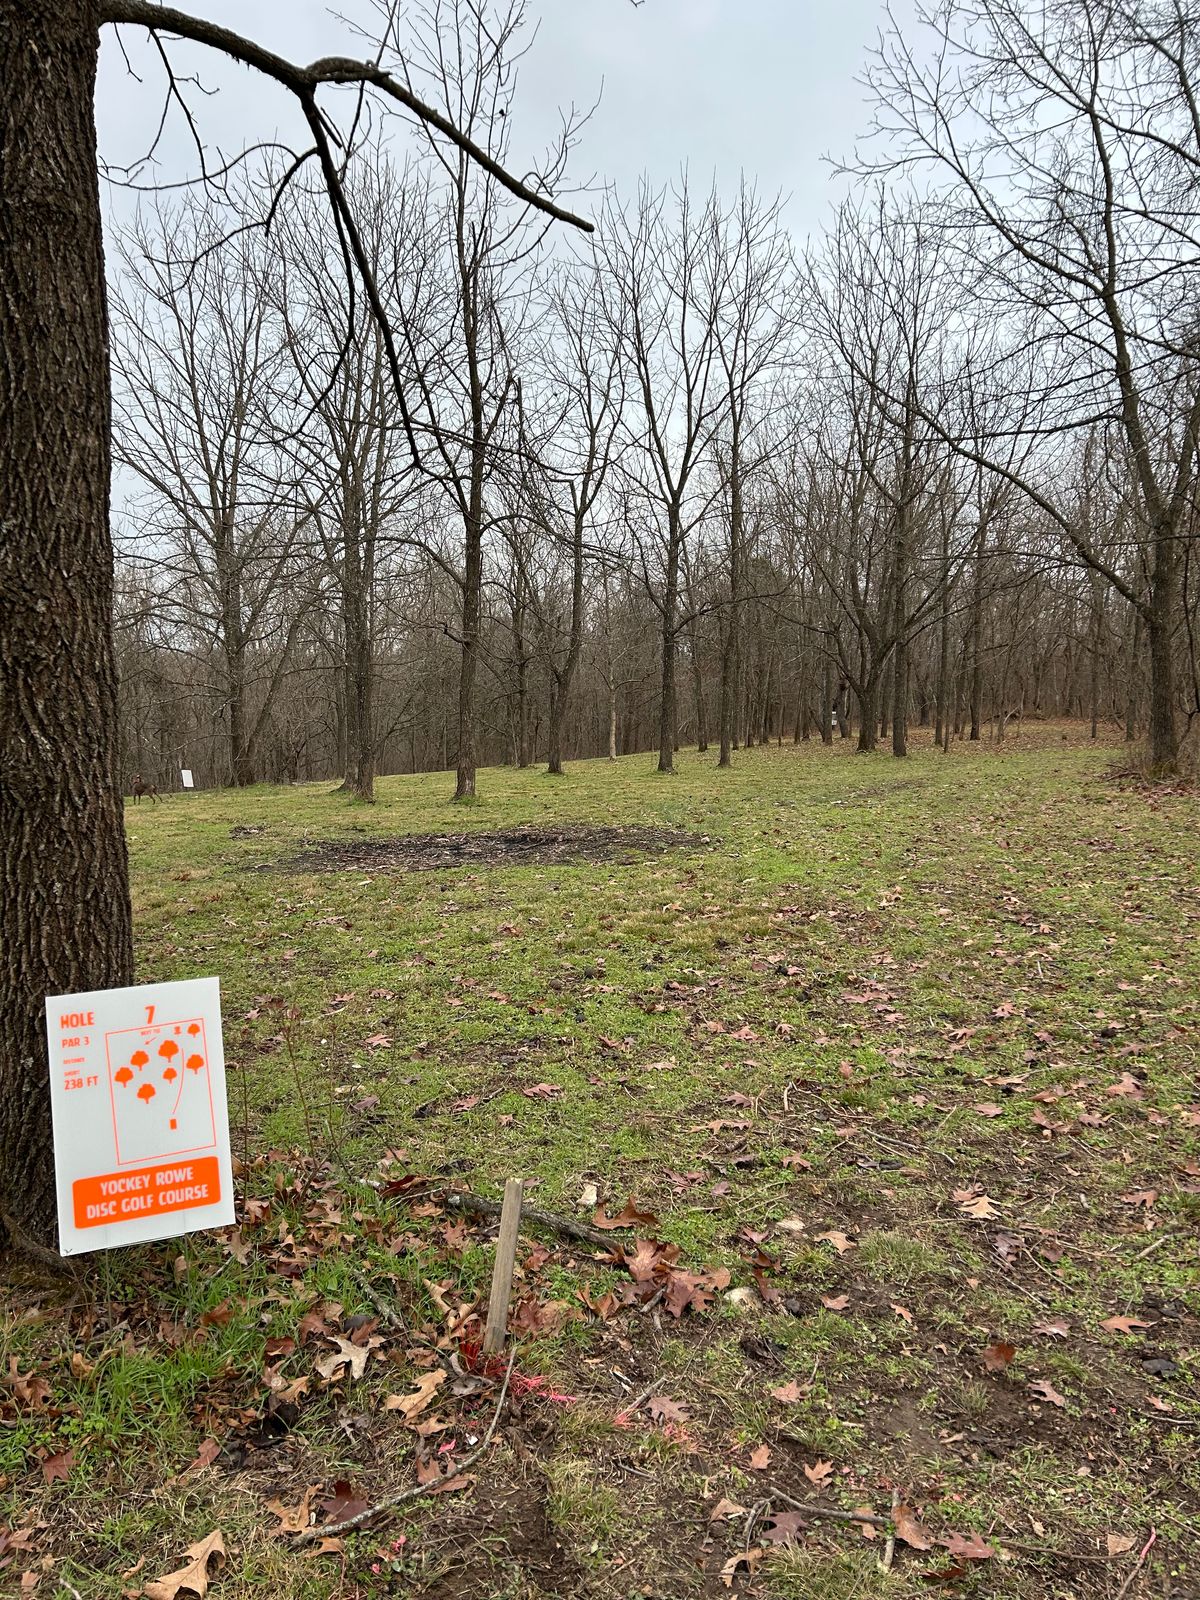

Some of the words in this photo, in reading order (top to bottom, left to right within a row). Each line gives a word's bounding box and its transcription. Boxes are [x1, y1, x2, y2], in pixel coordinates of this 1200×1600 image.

[60, 1012, 94, 1029] HOLE
[145, 1005, 156, 1024] 7
[61, 1037, 81, 1048] PAR
[84, 1036, 90, 1045] 3
[64, 1078, 84, 1090] 238
[87, 1076, 98, 1087] FT
[100, 1174, 151, 1196] YOCKEY
[156, 1166, 194, 1185] ROWE
[86, 1200, 117, 1219] DISC
[121, 1193, 154, 1212] GOLF
[159, 1184, 209, 1205] COURSE
